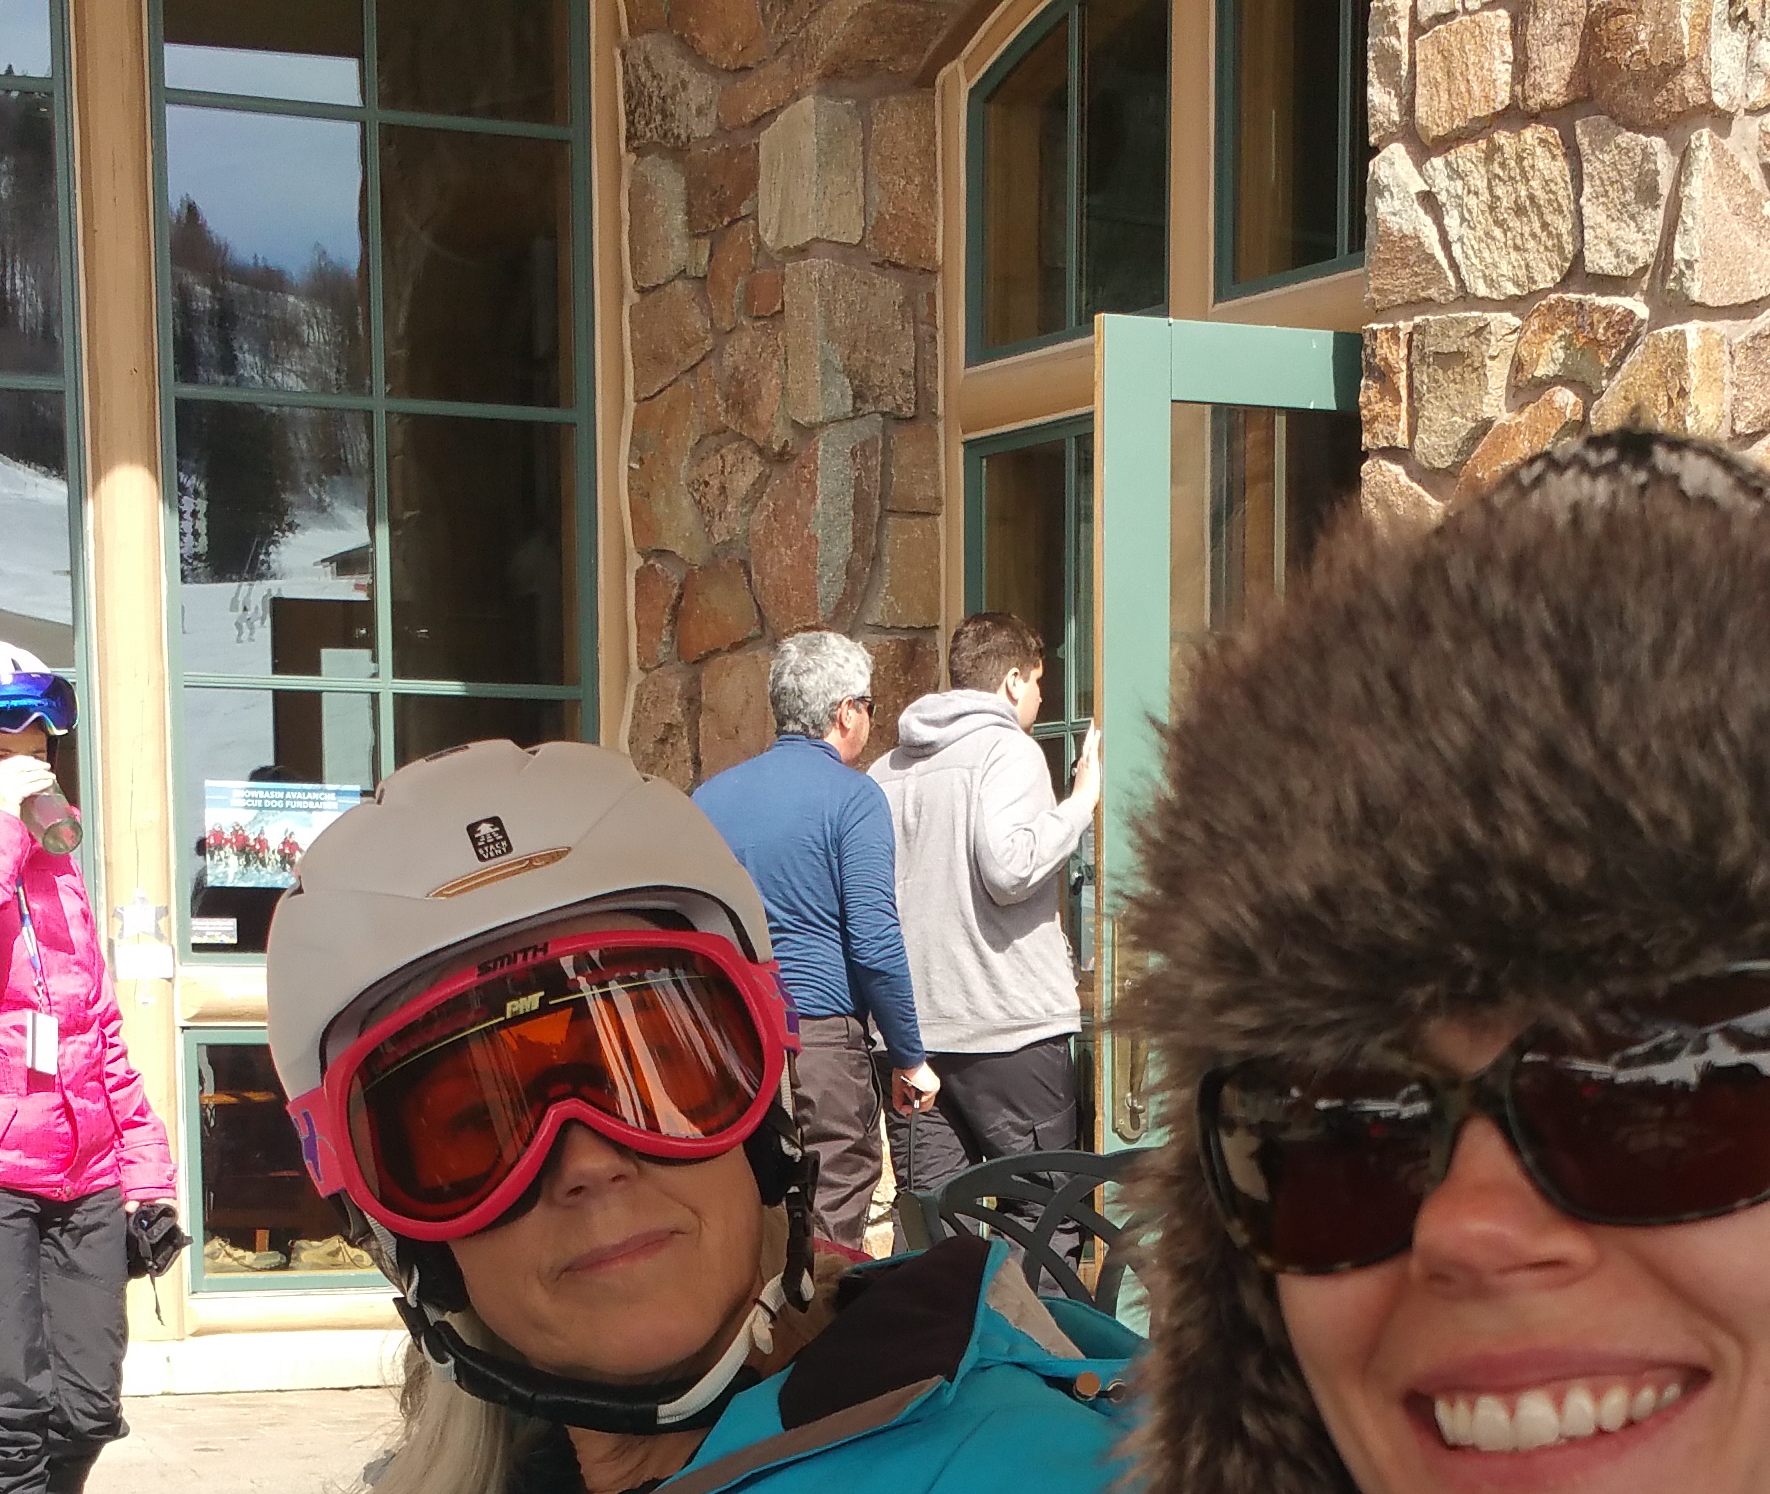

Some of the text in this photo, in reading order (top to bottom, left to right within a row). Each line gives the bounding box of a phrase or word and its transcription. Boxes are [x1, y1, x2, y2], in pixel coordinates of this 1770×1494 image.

[285, 791, 336, 800] AVALANCHE
[264, 800, 284, 808] DOG
[285, 800, 338, 809] FUNDRAISER
[477, 941, 549, 977] SMITH
